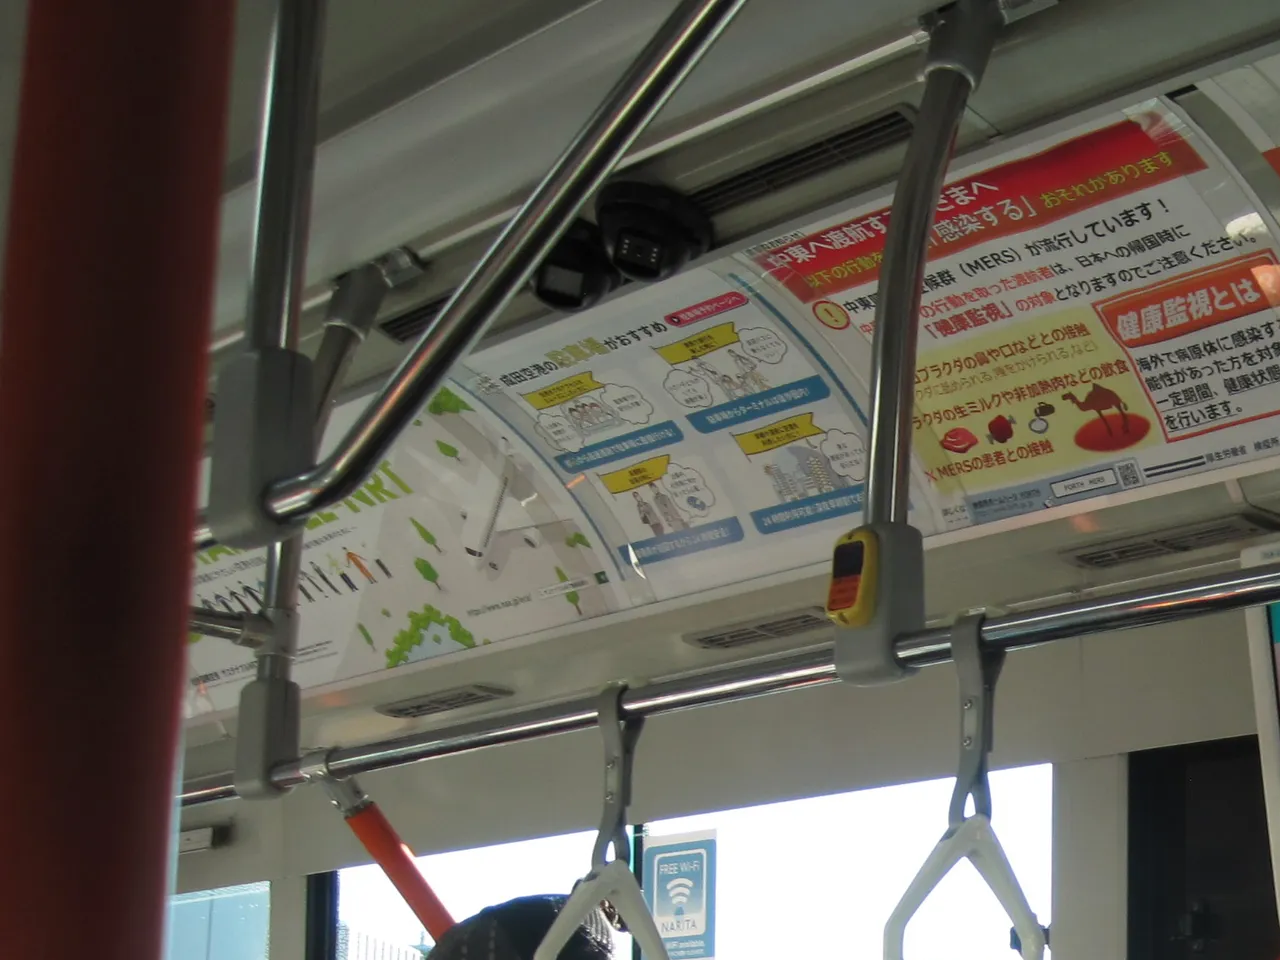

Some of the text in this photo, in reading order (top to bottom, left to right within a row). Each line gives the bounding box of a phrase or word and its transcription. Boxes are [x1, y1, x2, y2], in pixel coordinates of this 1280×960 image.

[767, 180, 1000, 267] 中東へ渡航すさまへ
[1115, 278, 1262, 342] 健康監視とは
[1164, 399, 1244, 431] を行います。
[937, 438, 1055, 480] MERSの患者との接触
[658, 862, 679, 876] FREE
[660, 918, 698, 935] NARITA
